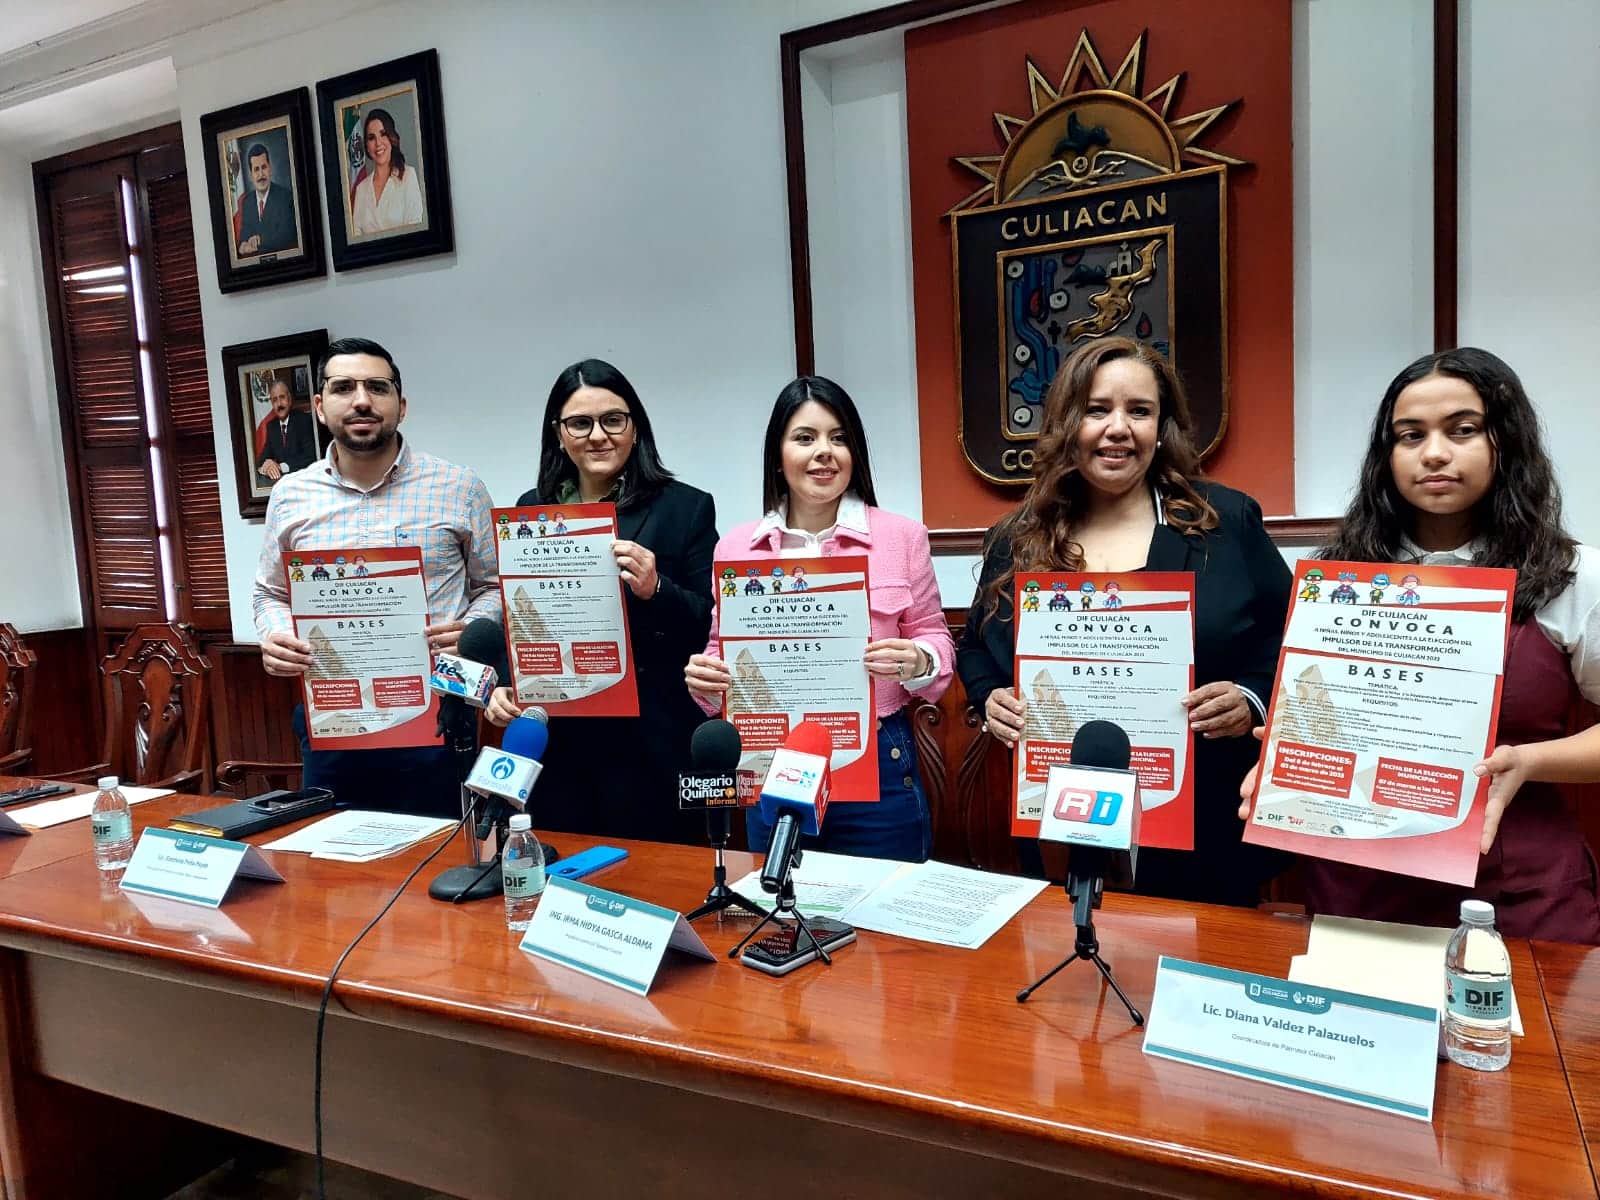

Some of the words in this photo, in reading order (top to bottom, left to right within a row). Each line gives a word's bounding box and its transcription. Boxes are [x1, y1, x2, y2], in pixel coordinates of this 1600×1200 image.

[1001, 192, 1167, 240] CULIACAN
[523, 546, 590, 555] CONVOCA
[540, 580, 582, 590] BASES
[319, 587, 394, 597] CONVOCA
[751, 603, 835, 614] CONVOCA
[1362, 609, 1377, 617] DIF
[1378, 611, 1428, 621] CULIACÁN
[337, 620, 385, 629] BASES
[1055, 623, 1152, 633] CONVOCA
[1334, 616, 1454, 635] CONVOCA
[769, 643, 822, 653] BASES
[1322, 636, 1361, 646] IMPULSOR
[1385, 642, 1461, 655] TRANSFORMACIÓN
[1073, 666, 1134, 677] BASES
[1348, 664, 1424, 683] BASES
[1413, 768, 1423, 776] LA
[681, 774, 733, 790] Olegario
[706, 797, 736, 806] Informa
[1268, 813, 1285, 821] DIF
[93, 826, 111, 835] DIF
[505, 876, 527, 887] DIF
[563, 915, 580, 927] IRMA
[580, 920, 601, 933] NIDYA
[601, 927, 623, 941] GASCA
[623, 934, 653, 951] ALDAMA
[1306, 994, 1326, 1005] DIF
[1465, 989, 1504, 1006] DIF
[1203, 1003, 1222, 1017] Lic.
[1226, 1008, 1259, 1025] Diana
[1262, 1015, 1305, 1034] Valdez
[1308, 1024, 1375, 1048] Palazuelos
